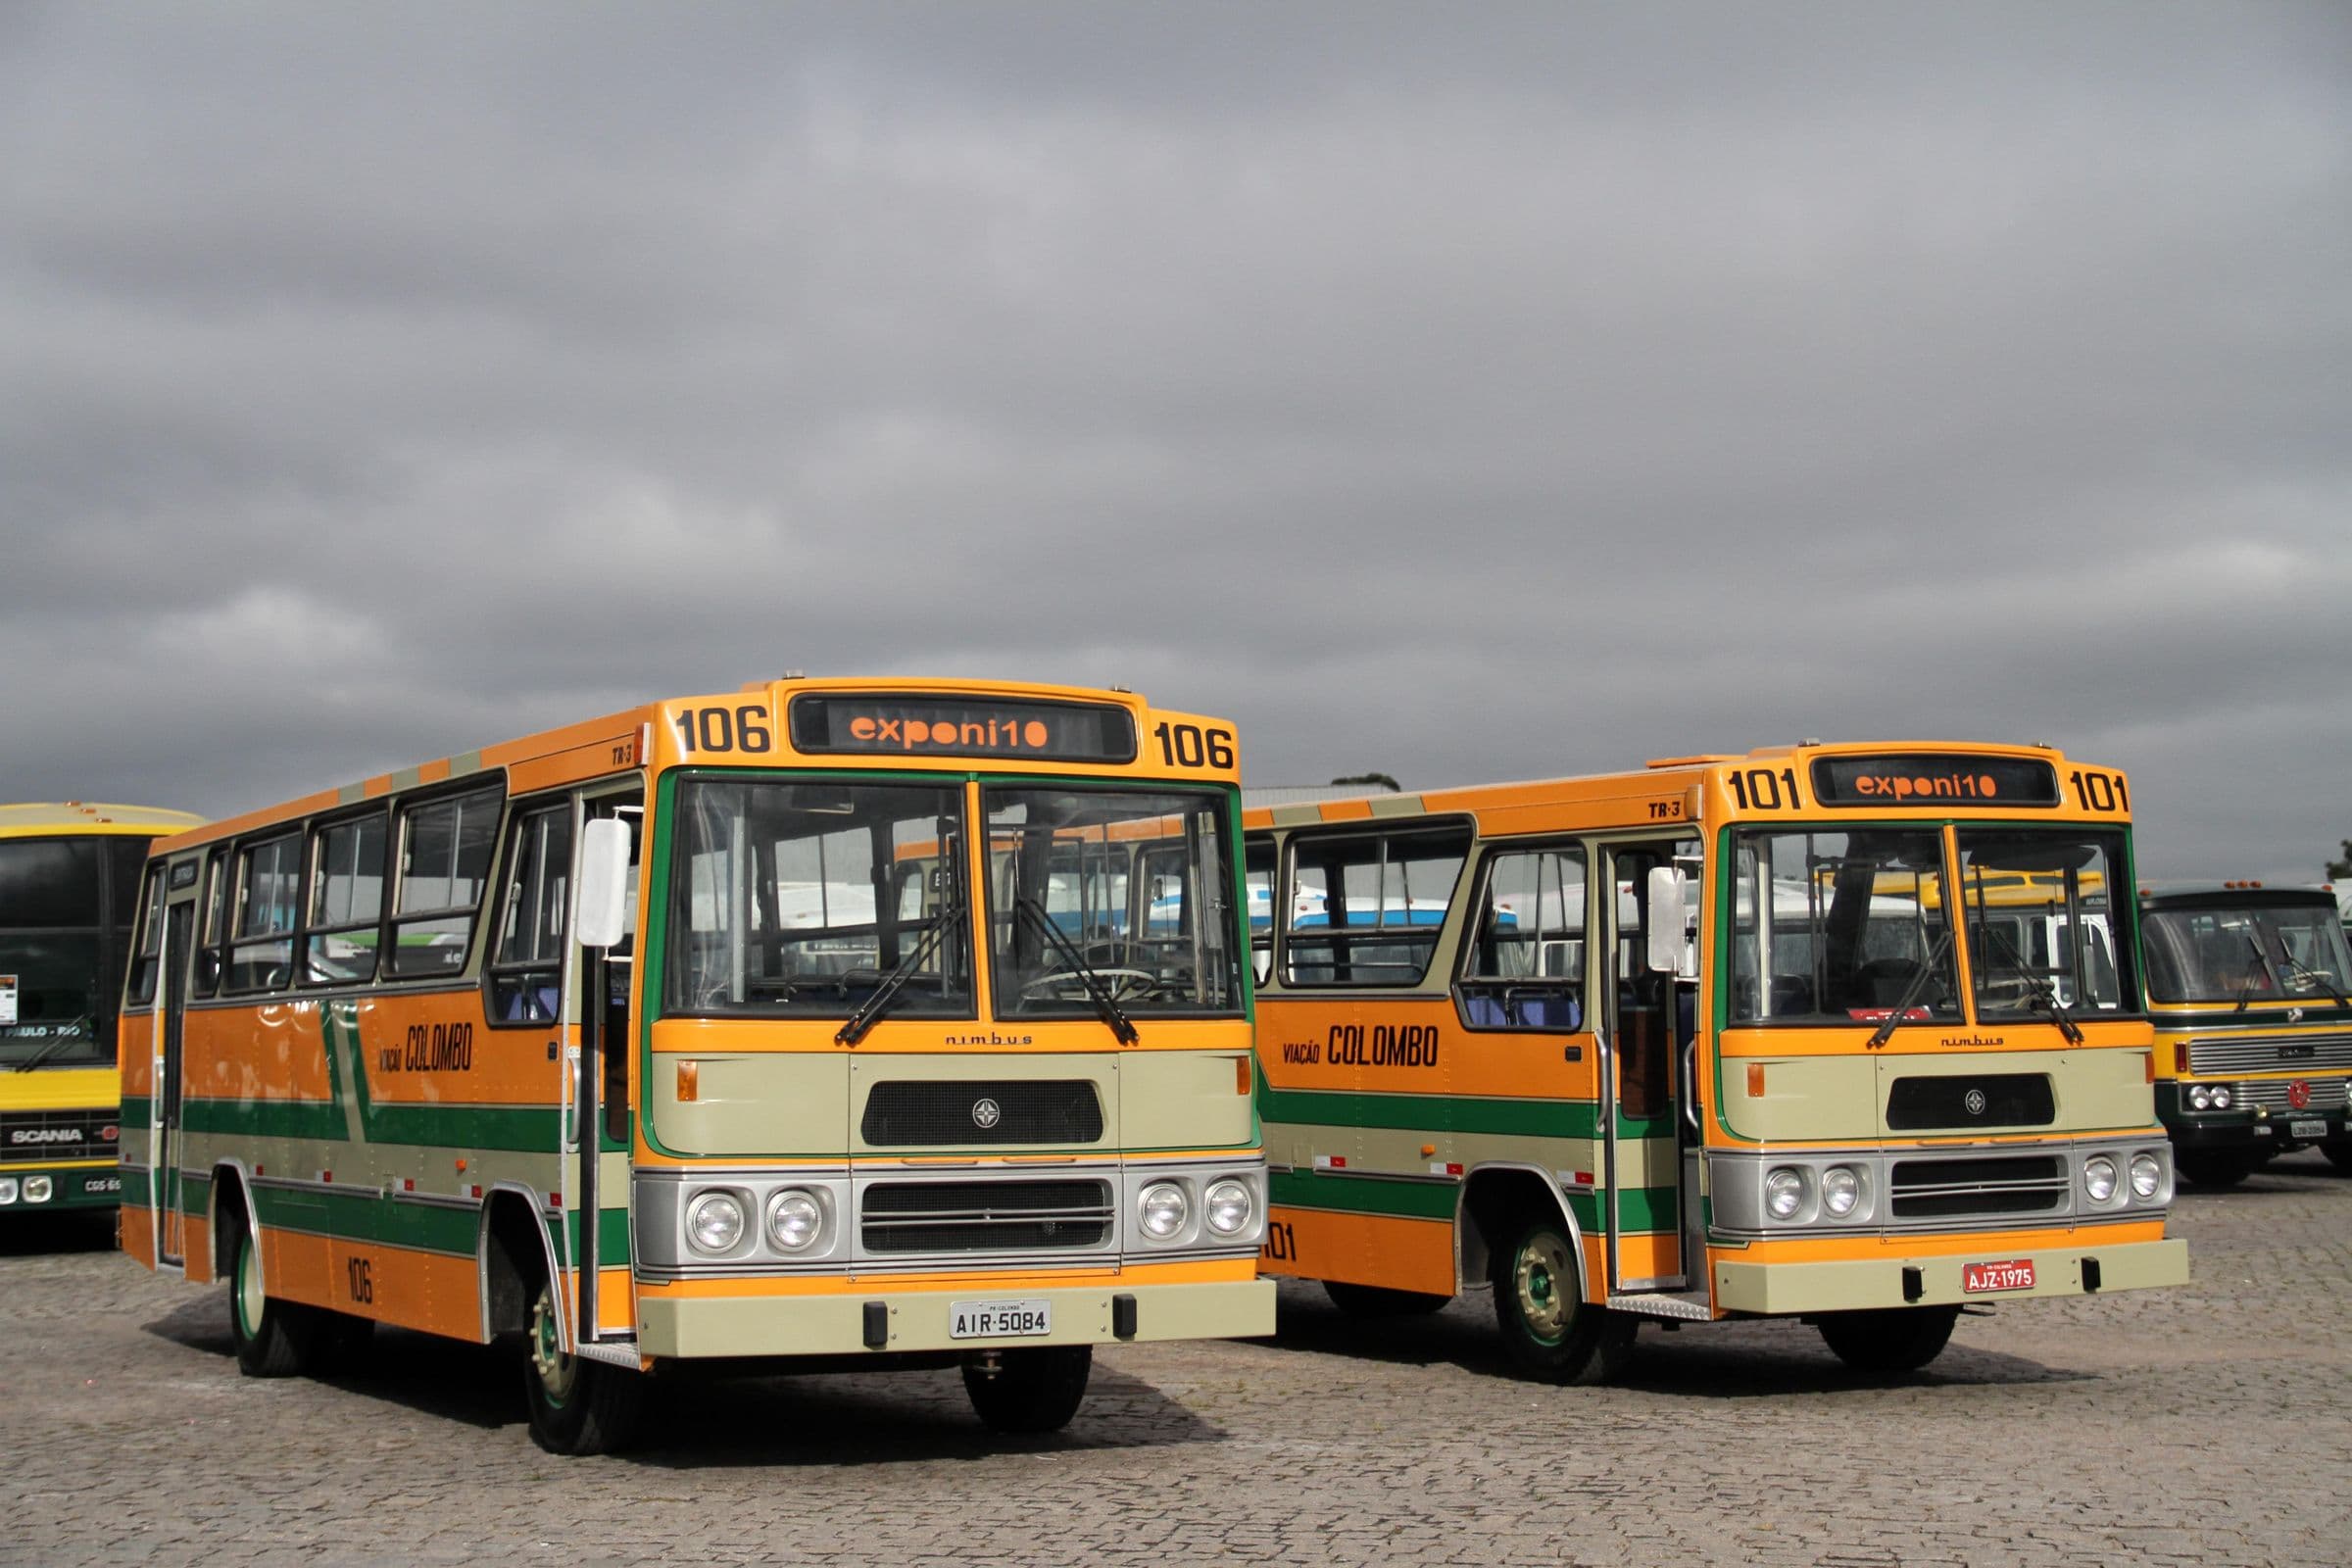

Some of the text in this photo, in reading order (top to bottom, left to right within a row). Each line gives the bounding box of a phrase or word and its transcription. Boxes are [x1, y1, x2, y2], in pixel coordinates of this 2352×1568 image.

[676, 706, 770, 753] 106
[850, 717, 1048, 750] exponi10
[1153, 721, 1234, 769] 106
[1728, 768, 1801, 810] 101
[1855, 773, 1996, 801] exponi10
[2070, 770, 2129, 812] 101
[406, 1022, 472, 1071] COLOMBO
[946, 1031, 1032, 1045] nimbus
[1328, 1025, 1439, 1067] COLOMBO
[1941, 1034, 2004, 1047] nimbus
[12, 1129, 83, 1144] SCANIA
[348, 1256, 372, 1304] 106
